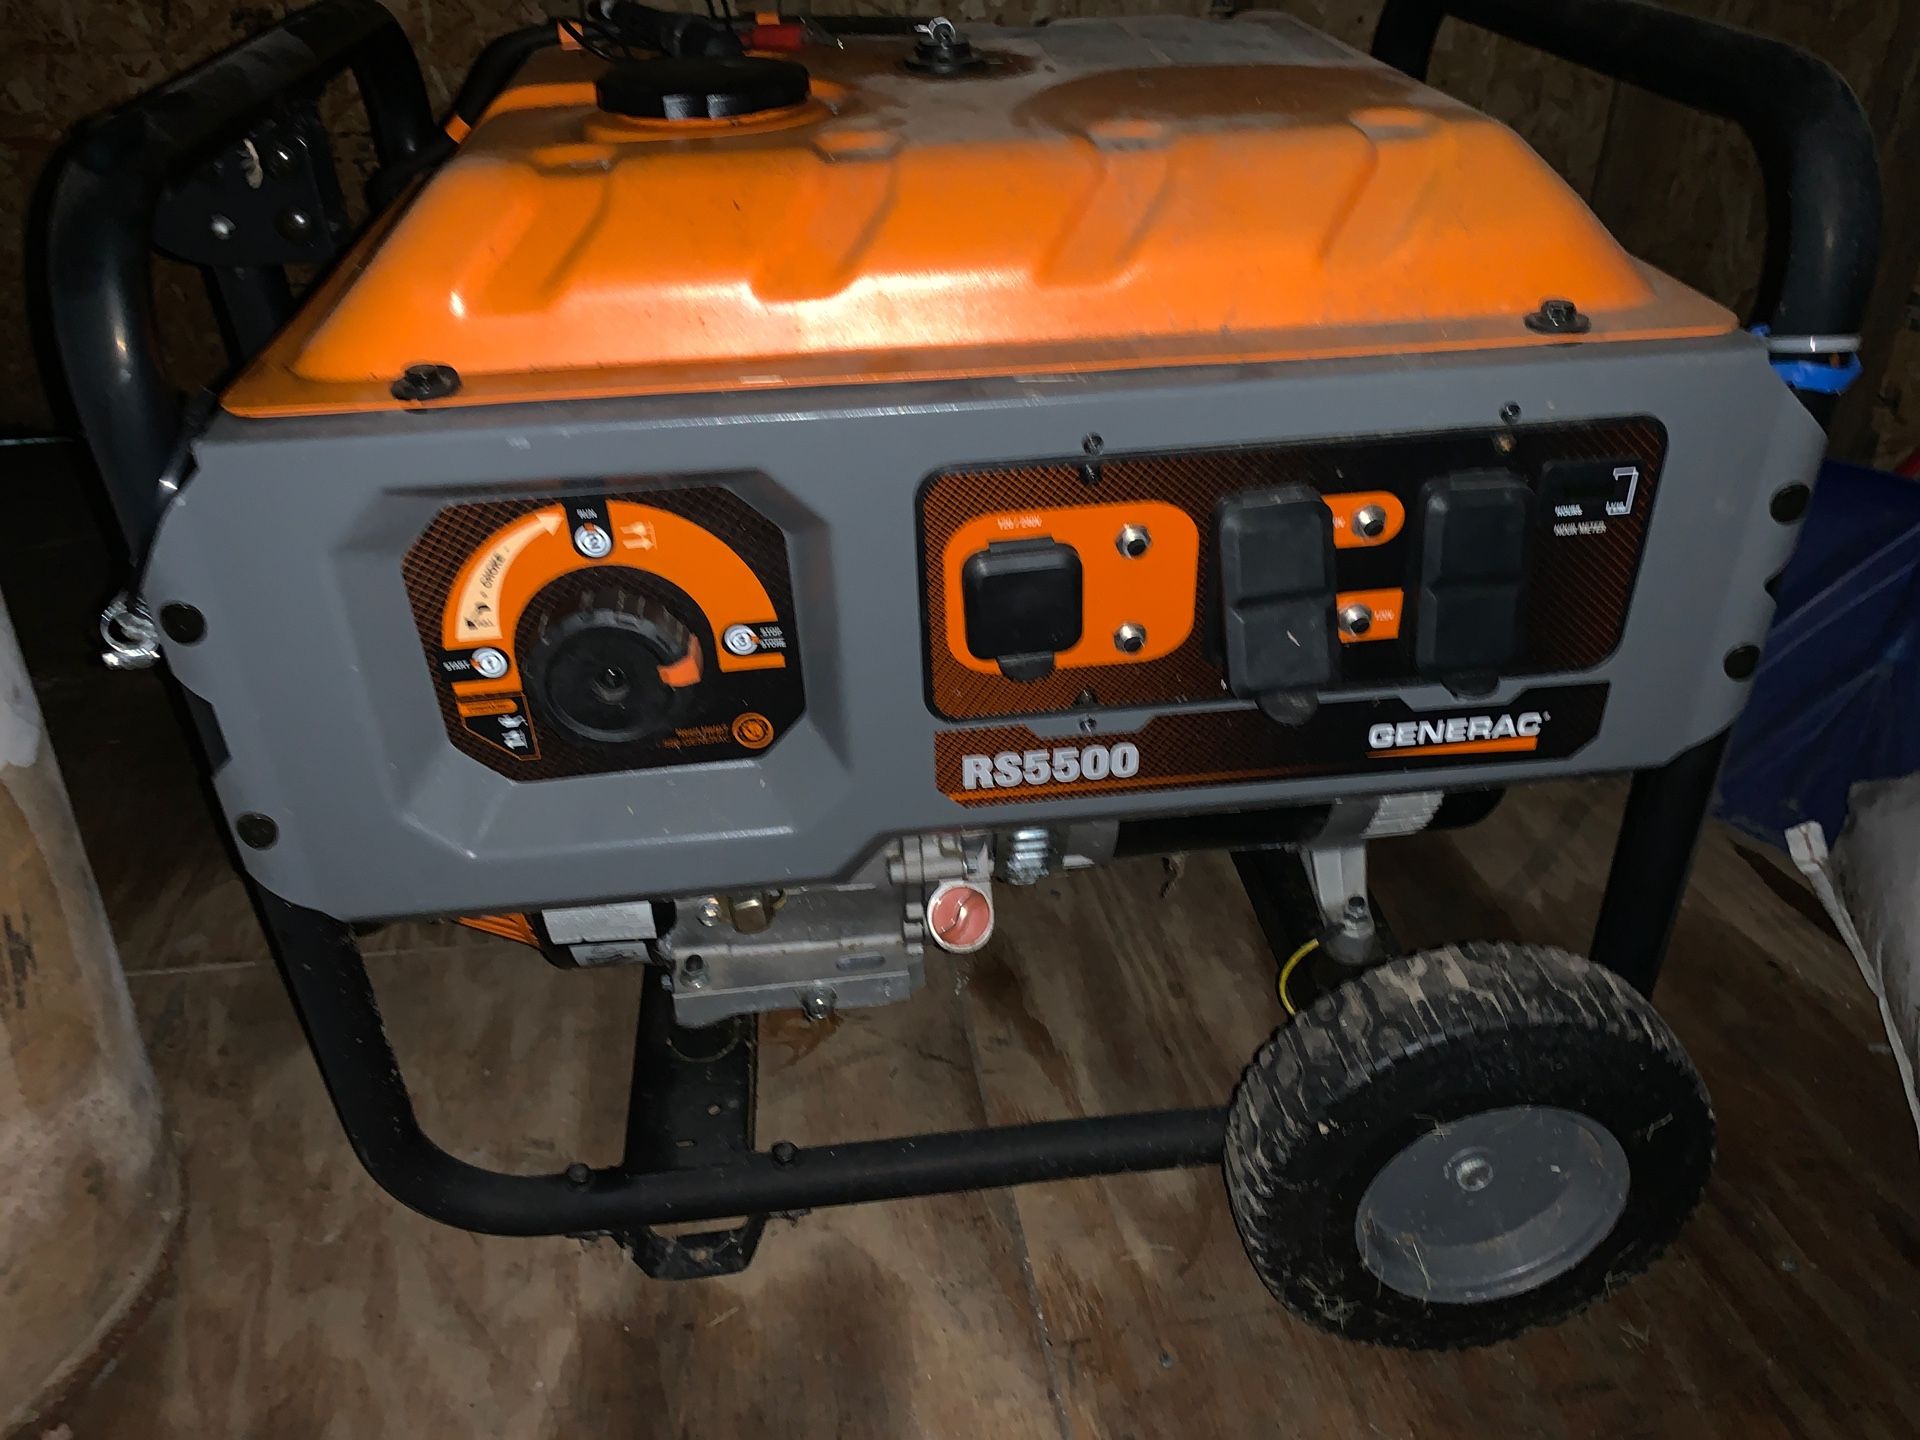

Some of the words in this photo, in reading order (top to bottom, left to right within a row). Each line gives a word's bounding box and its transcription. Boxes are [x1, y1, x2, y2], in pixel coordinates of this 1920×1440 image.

[576, 508, 598, 520] RUN
[1577, 520, 1607, 535] METER
[759, 626, 783, 637] STOP
[443, 659, 471, 671] START
[1368, 710, 1542, 749] GENERAC
[961, 741, 1140, 790] RS5500
